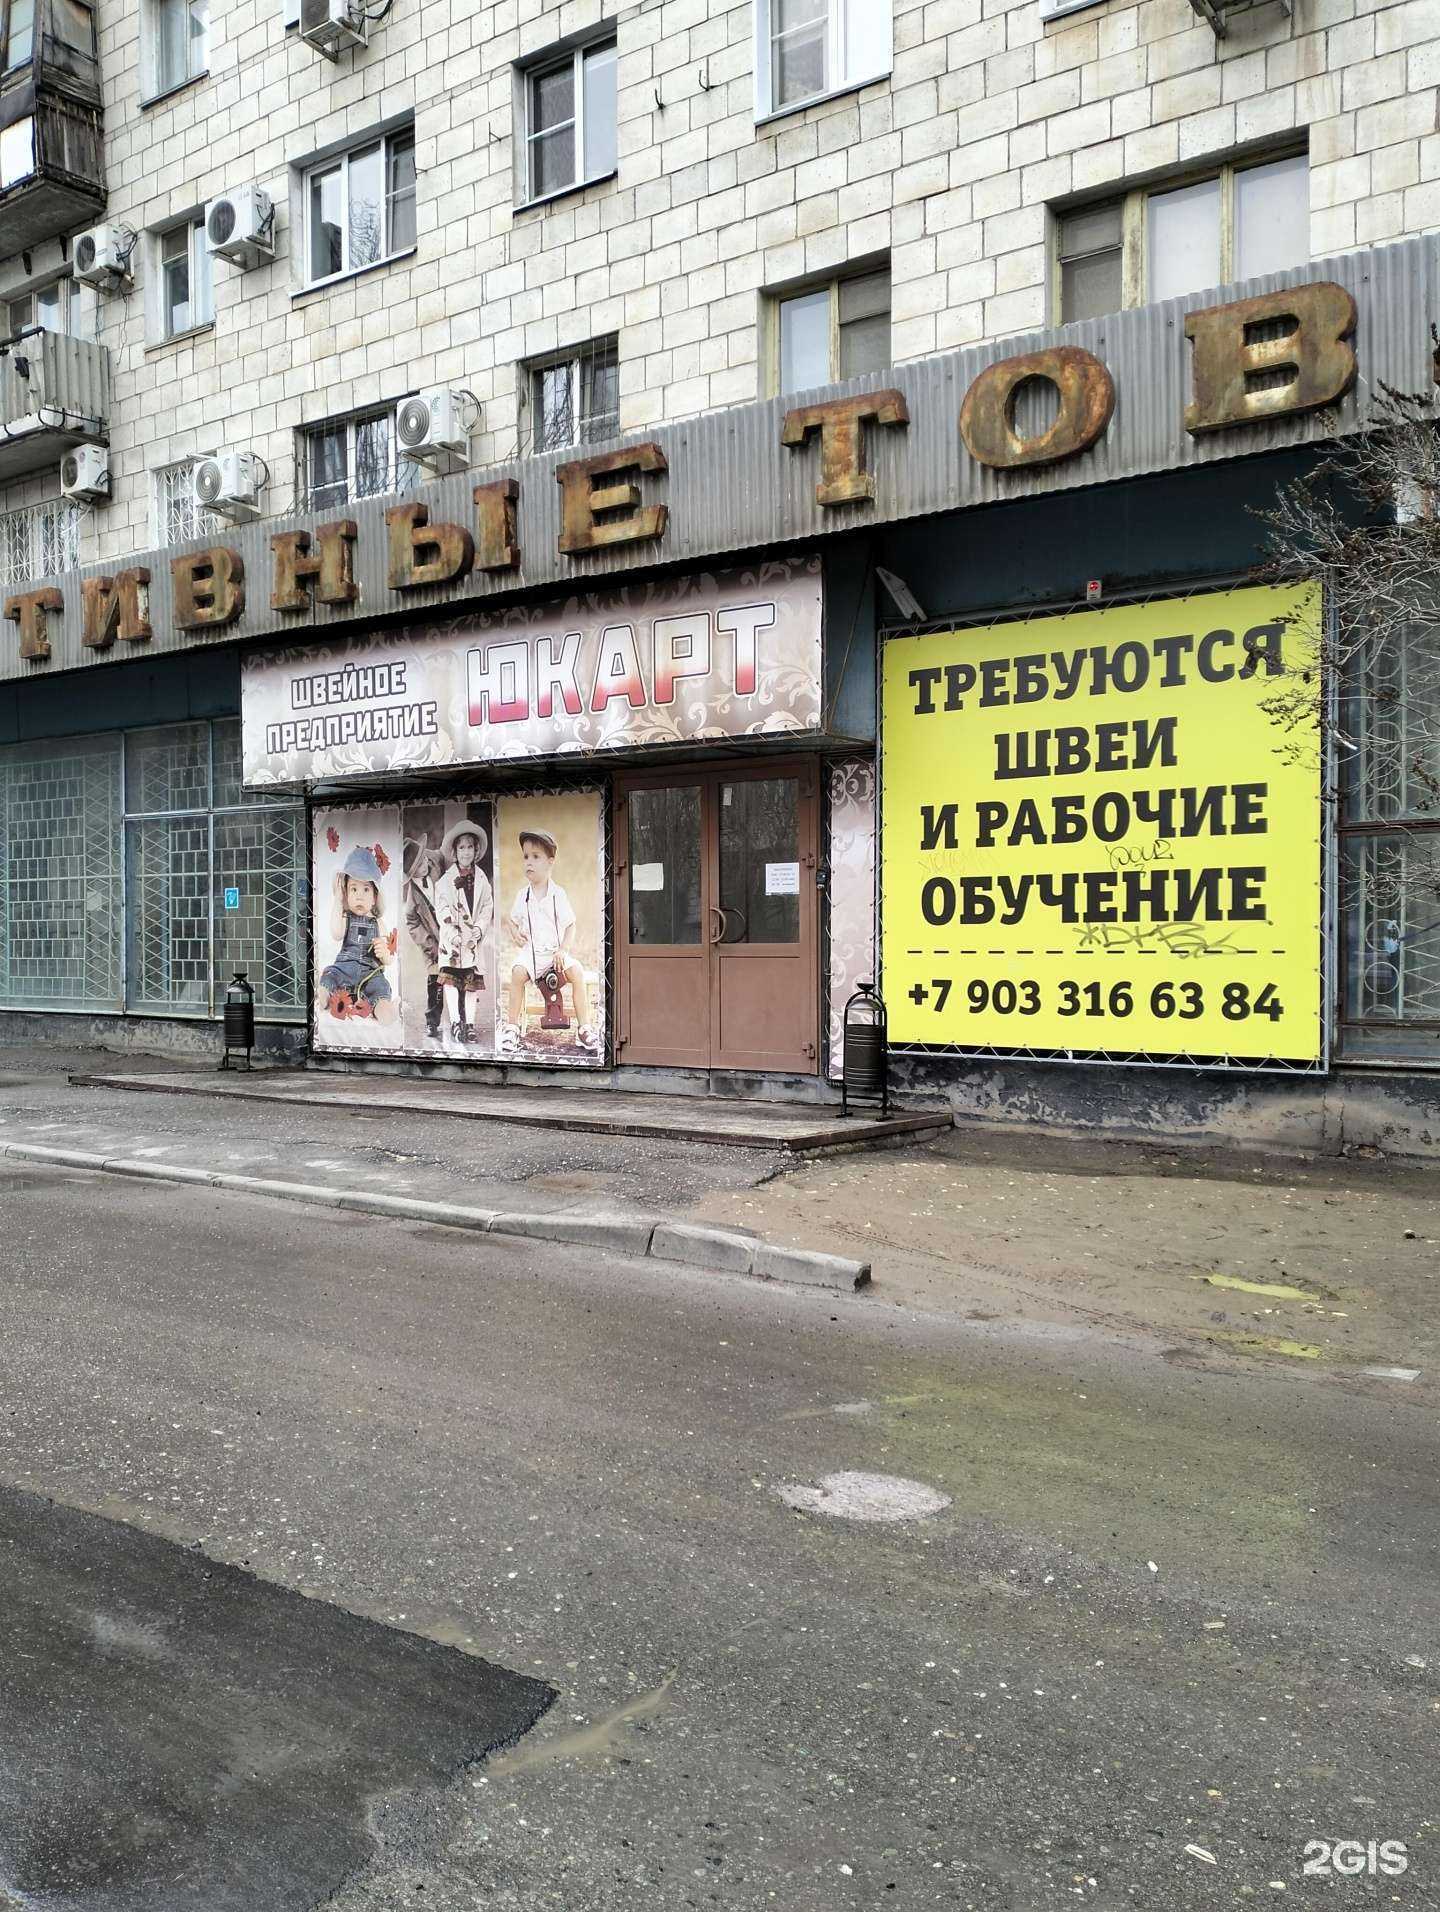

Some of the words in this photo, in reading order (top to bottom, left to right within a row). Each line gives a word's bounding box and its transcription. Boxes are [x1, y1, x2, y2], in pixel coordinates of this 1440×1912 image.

[5, 443, 669, 660] ТИВНЫЕ
[782, 281, 1440, 507] ТОВ
[291, 661, 406, 710] ШВЕЙНОЕ
[466, 602, 775, 727] ЮКАРТ
[908, 622, 1286, 715] ТРЕБУЮТСЯ
[266, 701, 438, 754] ПРЕДПРИЯТИЕ
[993, 717, 1178, 781] ШВЕИ
[920, 804, 959, 850] И
[975, 782, 1268, 848] РАБОЧИЕ
[921, 866, 1267, 926] ОБУЧЕНИЕ
[908, 979, 952, 1013] +7
[967, 979, 1042, 1015] 903
[1057, 981, 1134, 1018] 316
[1150, 981, 1205, 1020] 63
[1221, 982, 1284, 1022] 84
